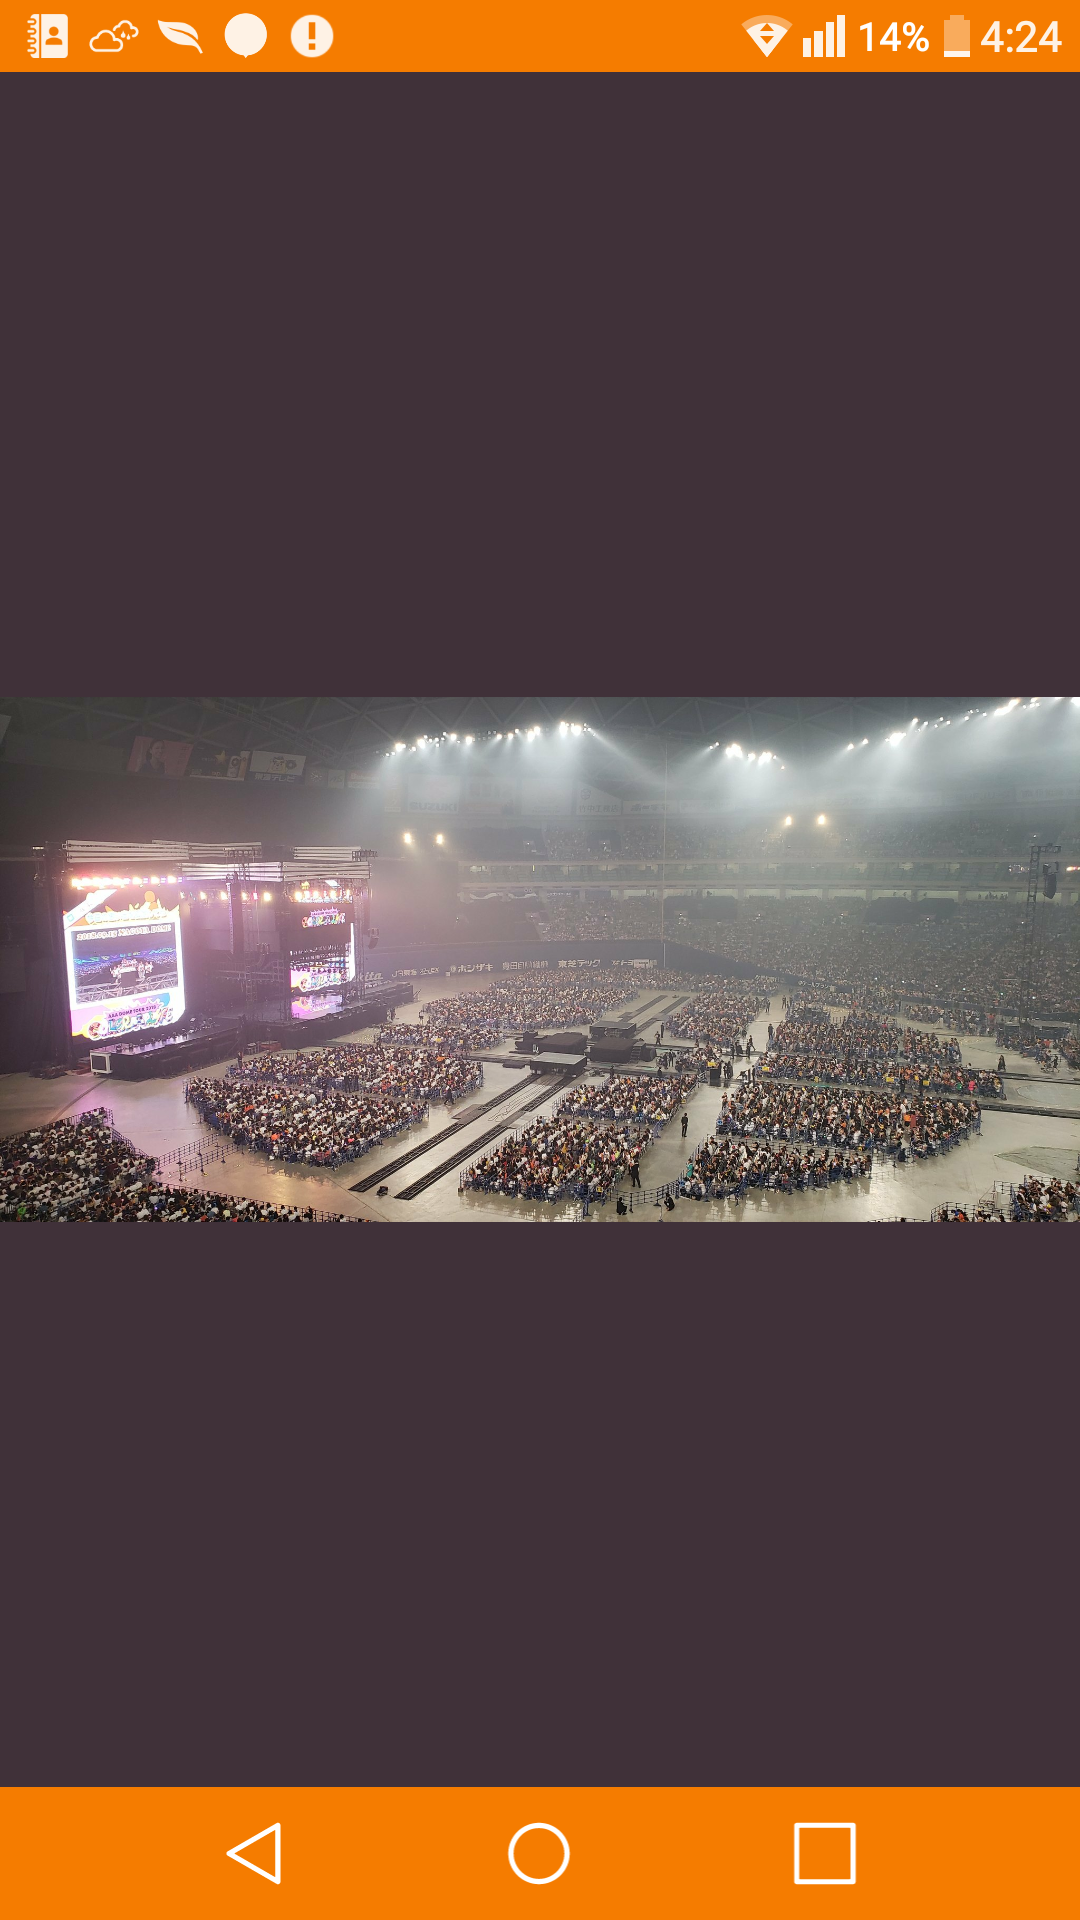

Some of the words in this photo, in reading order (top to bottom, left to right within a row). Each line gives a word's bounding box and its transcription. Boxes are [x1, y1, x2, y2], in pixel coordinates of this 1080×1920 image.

[254, 773, 296, 783] 東海テレビ
[409, 801, 459, 811] SUZUKI
[118, 926, 150, 937] NAGOYA
[150, 924, 172, 933] DOME
[457, 963, 494, 973] ホシザキ
[558, 959, 600, 968] 東芝テック
[108, 1012, 119, 1020] AAA
